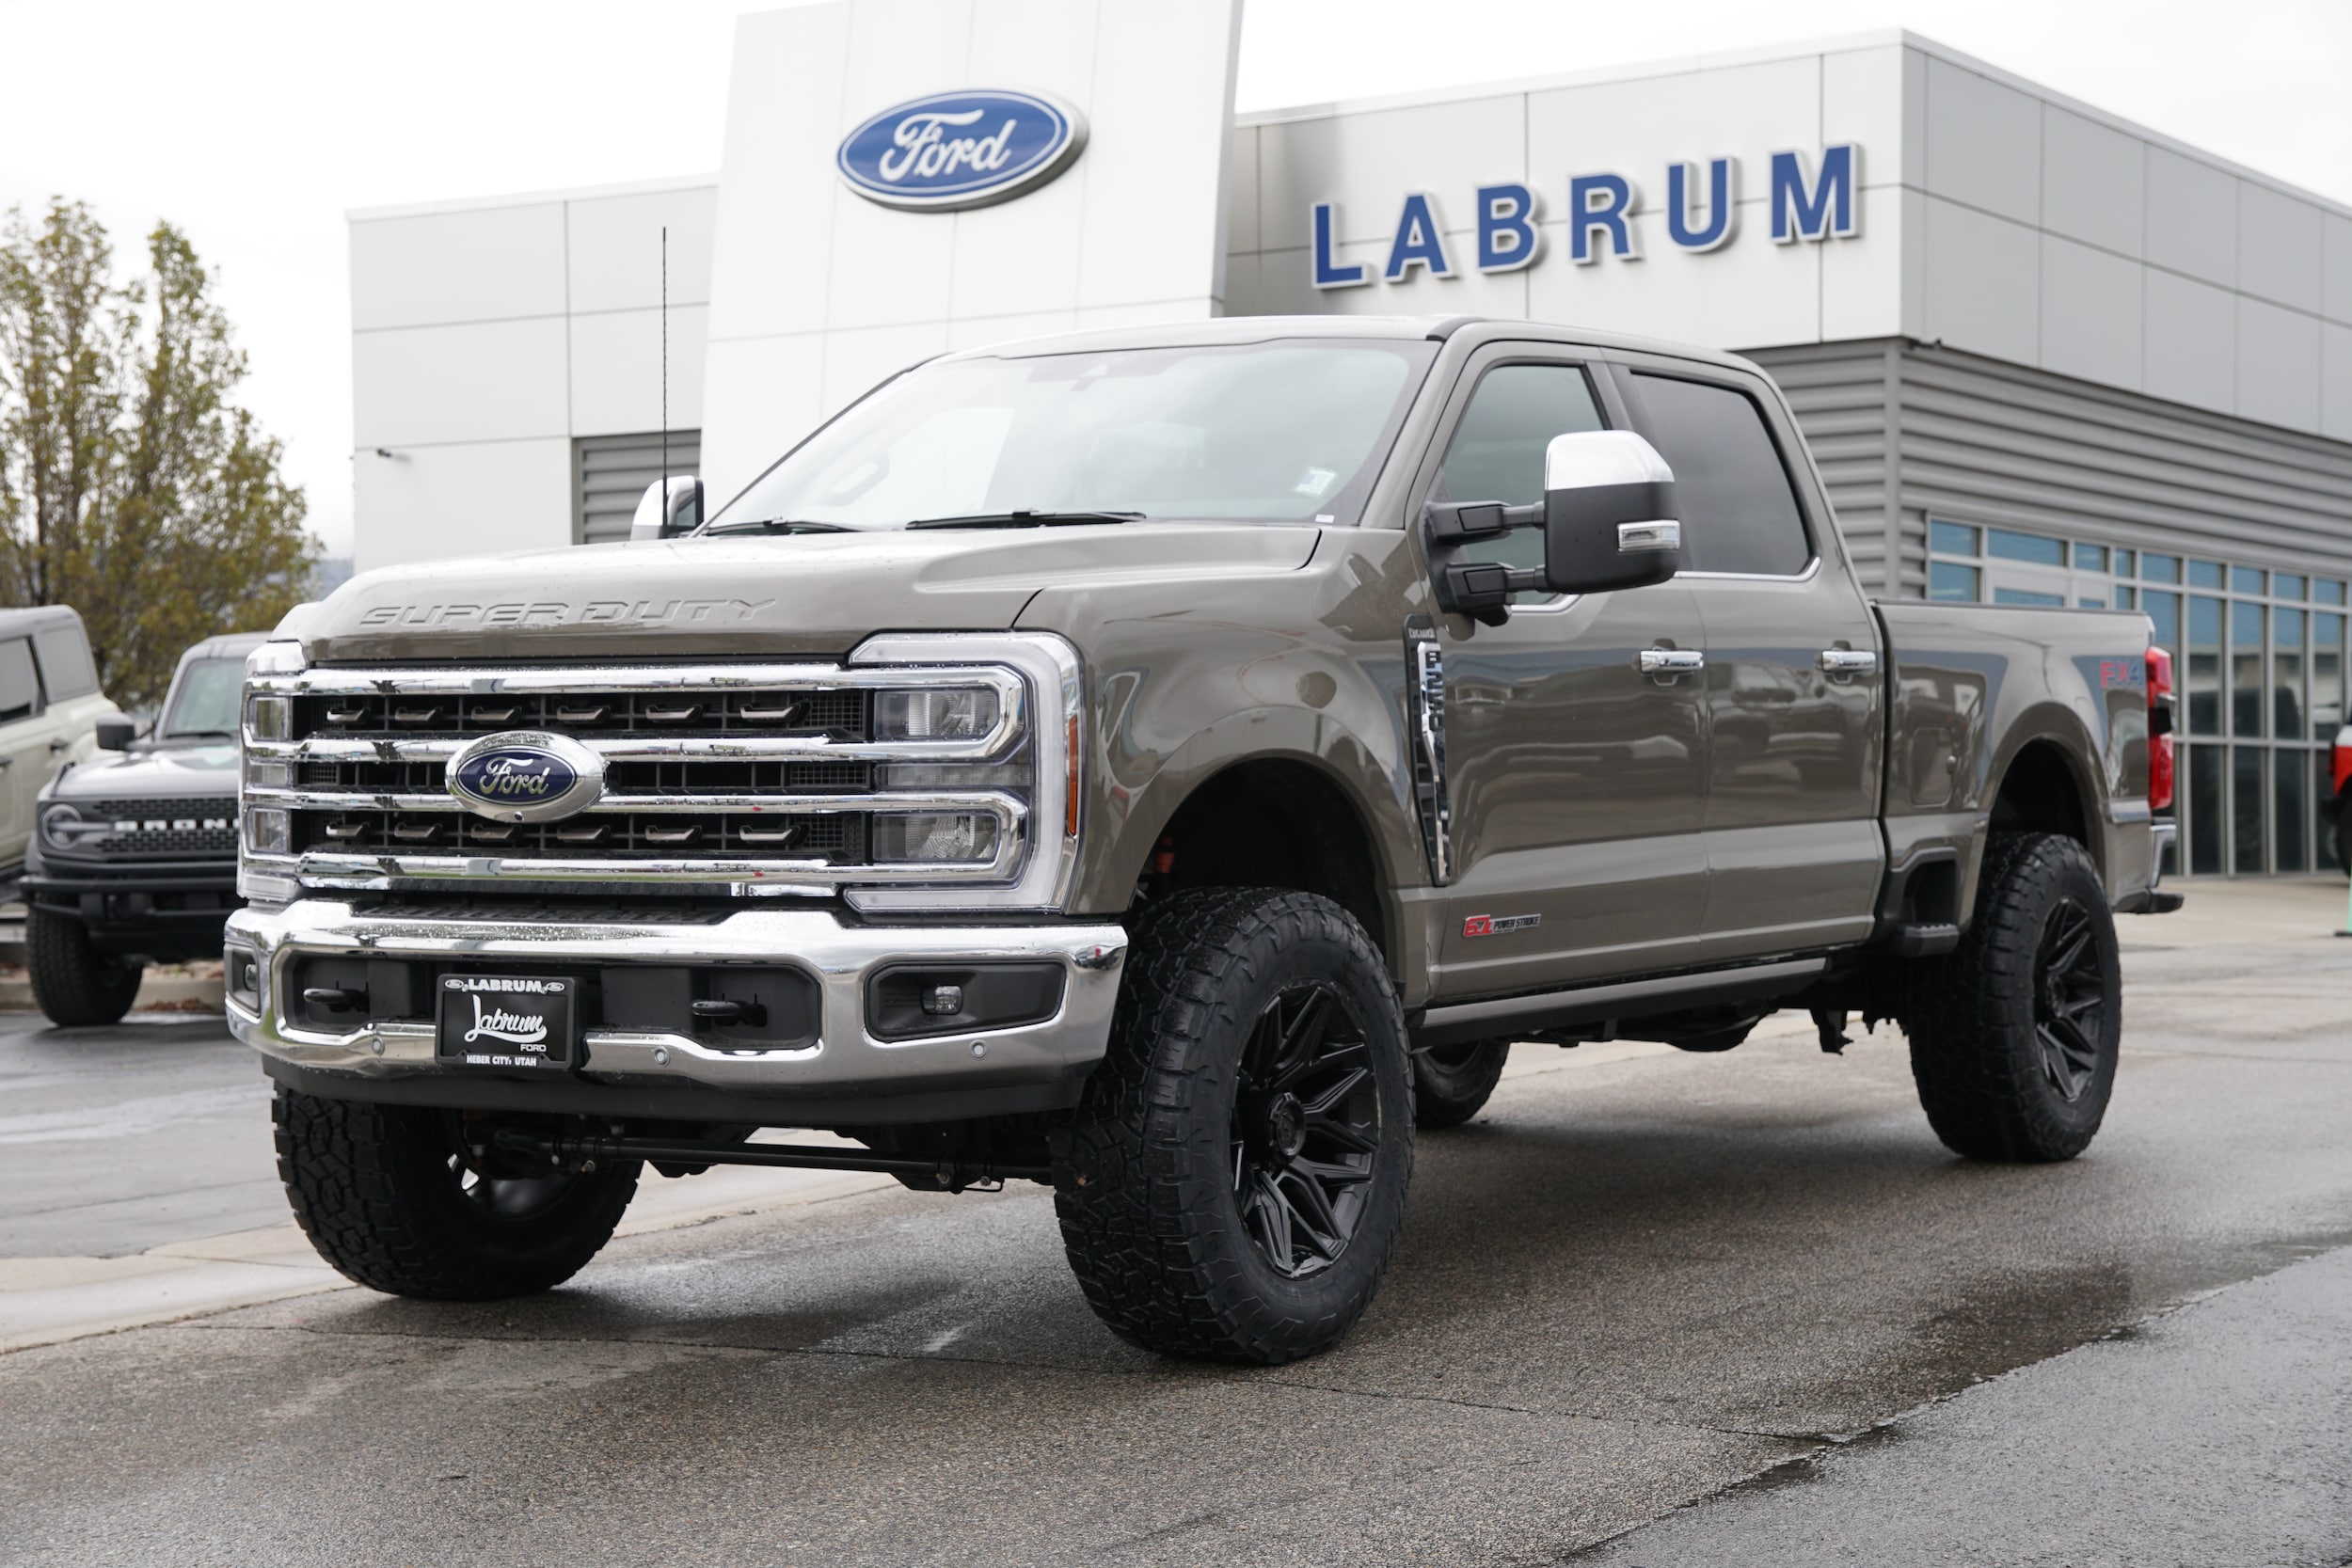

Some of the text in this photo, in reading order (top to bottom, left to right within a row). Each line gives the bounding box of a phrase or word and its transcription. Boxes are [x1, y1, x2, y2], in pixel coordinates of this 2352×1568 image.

[878, 108, 1018, 182] Ford
[1311, 142, 1861, 290] LABRUM
[359, 598, 777, 627] SUPER DUTY
[2100, 660, 2144, 689] FX4
[478, 756, 551, 795] Ford
[114, 817, 240, 832] BRON
[468, 979, 543, 992] LABRUM
[464, 993, 548, 1043] Labrum
[467, 1054, 537, 1067] HEBER CITY, UTAH
[520, 1044, 547, 1053] FORD
